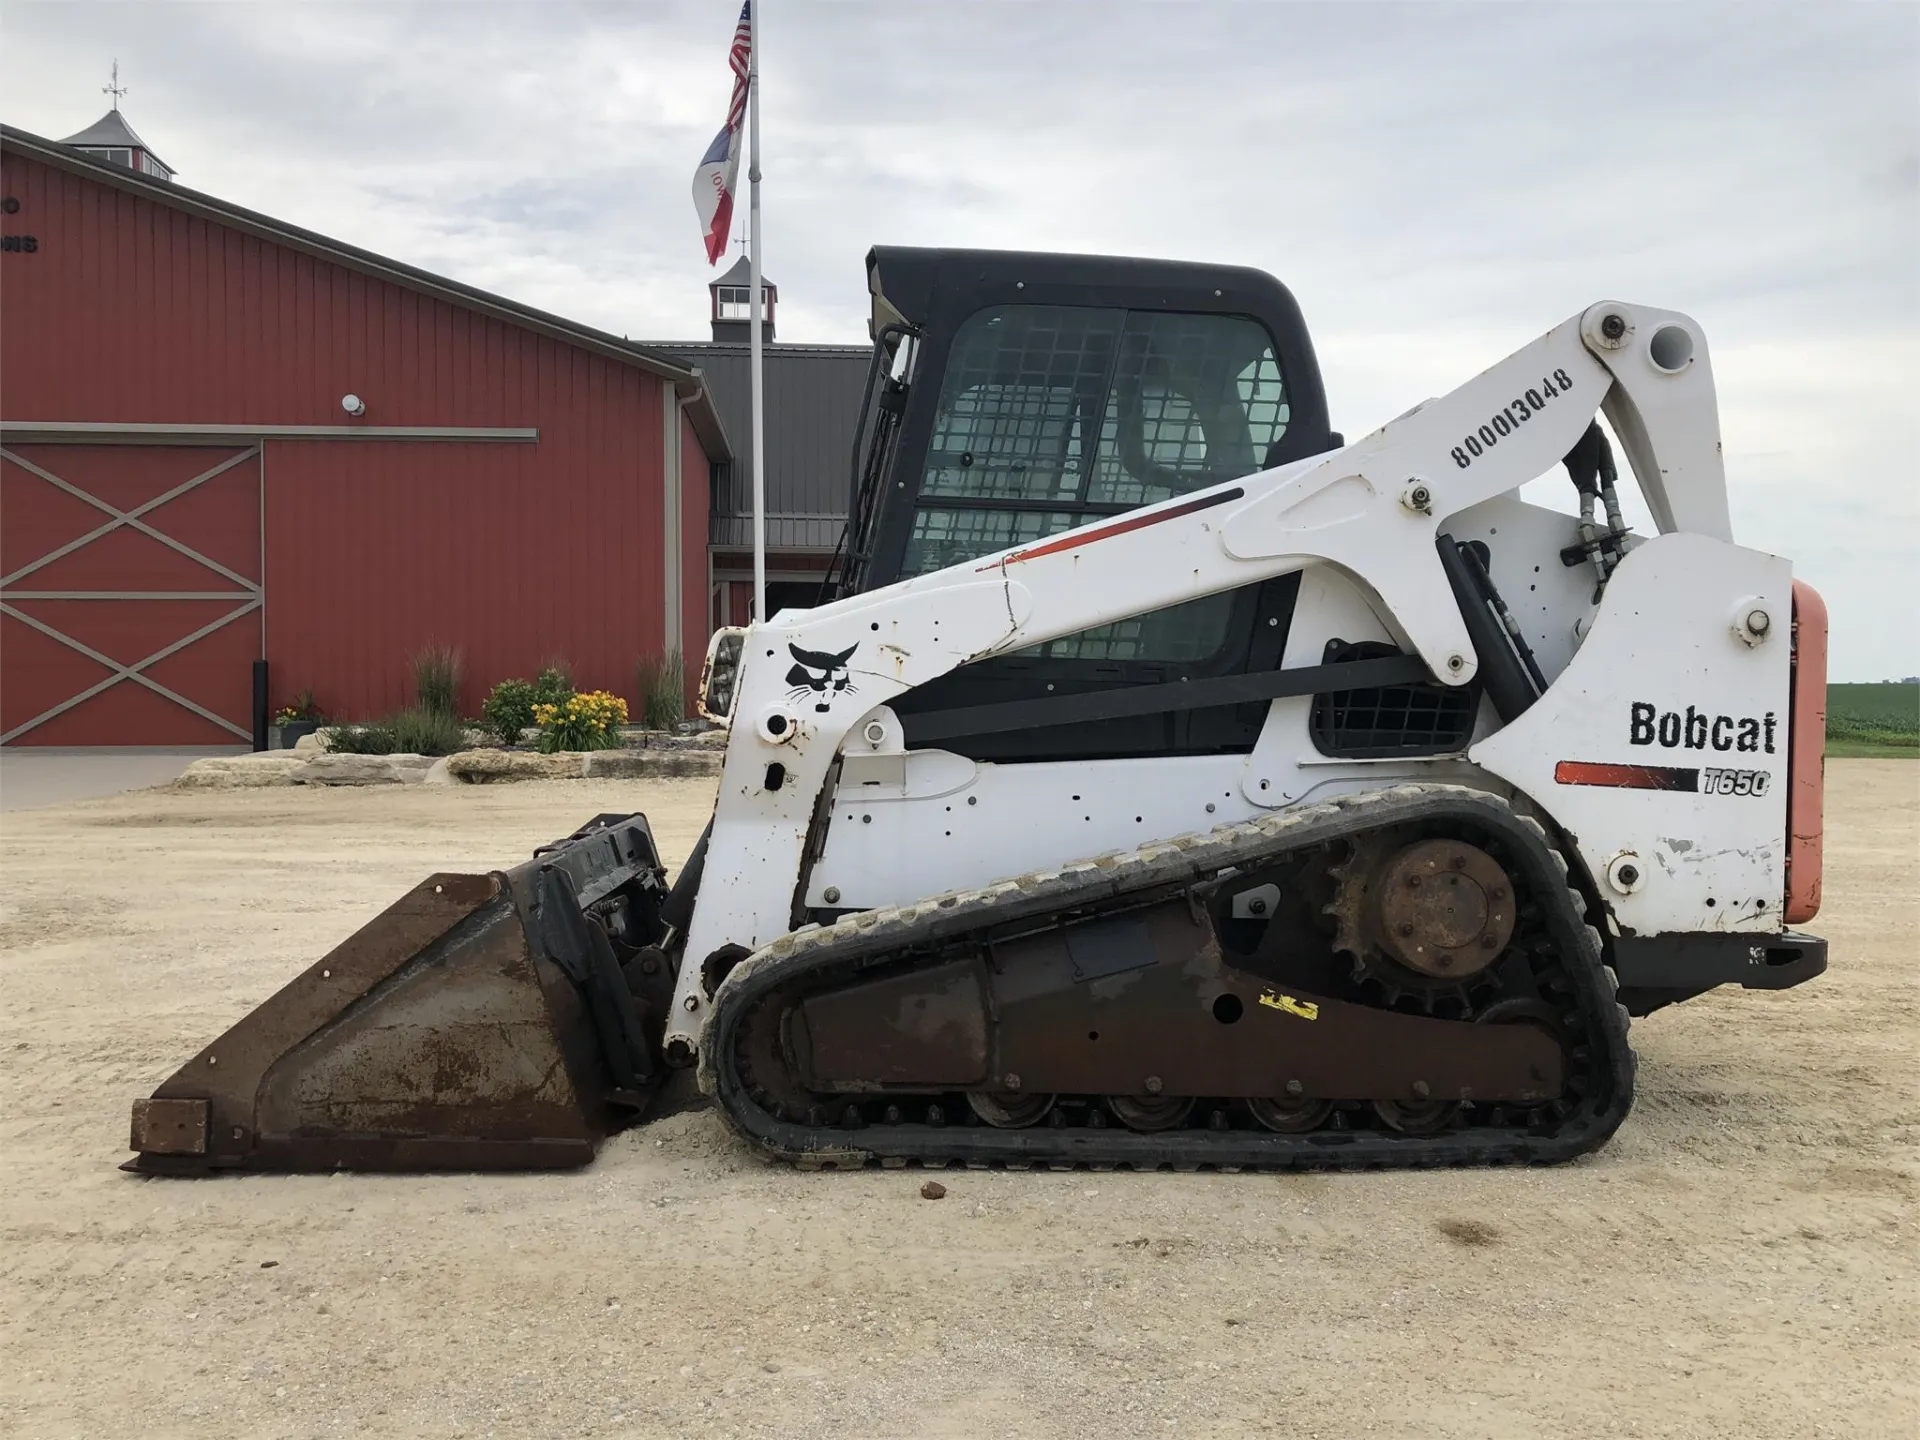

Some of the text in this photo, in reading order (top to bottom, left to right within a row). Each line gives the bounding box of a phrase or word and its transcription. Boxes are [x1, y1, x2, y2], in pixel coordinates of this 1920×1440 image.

[711, 171, 726, 200] IOW
[1630, 701, 1777, 754] Bobcat
[1704, 767, 1771, 797] T650
